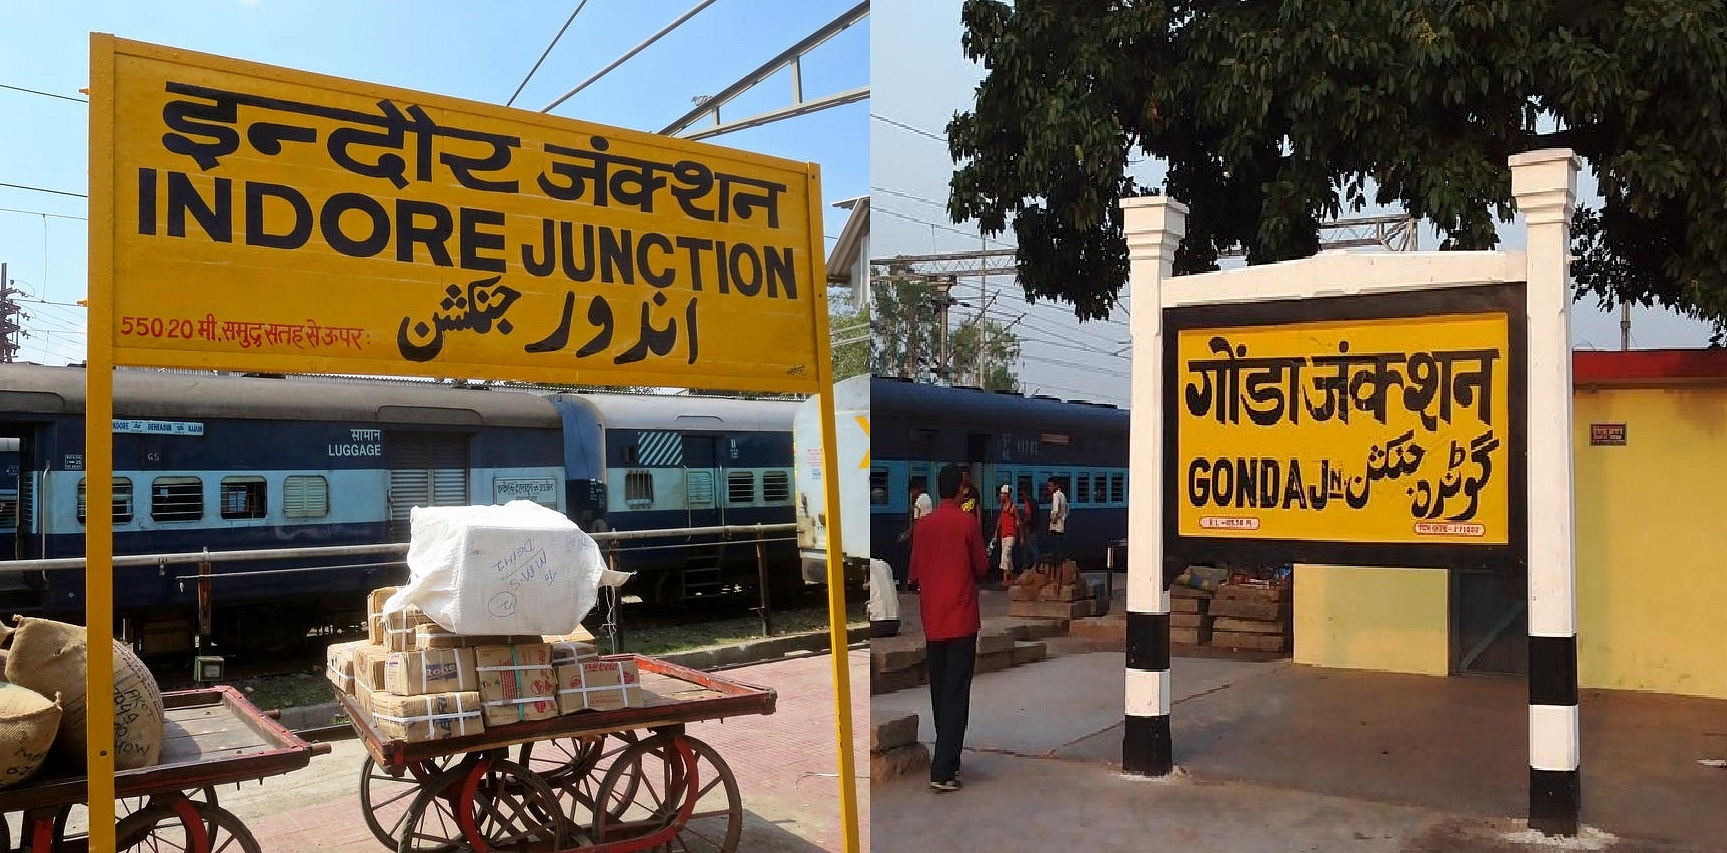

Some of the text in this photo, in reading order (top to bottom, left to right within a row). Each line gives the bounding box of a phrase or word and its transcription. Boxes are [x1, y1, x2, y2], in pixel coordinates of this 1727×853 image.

[161, 81, 787, 229] इन्दौर जंक्शन
[138, 166, 798, 300] INDORE JUNCTION
[328, 444, 381, 457] LUGGAGE
[350, 428, 381, 442] सामान
